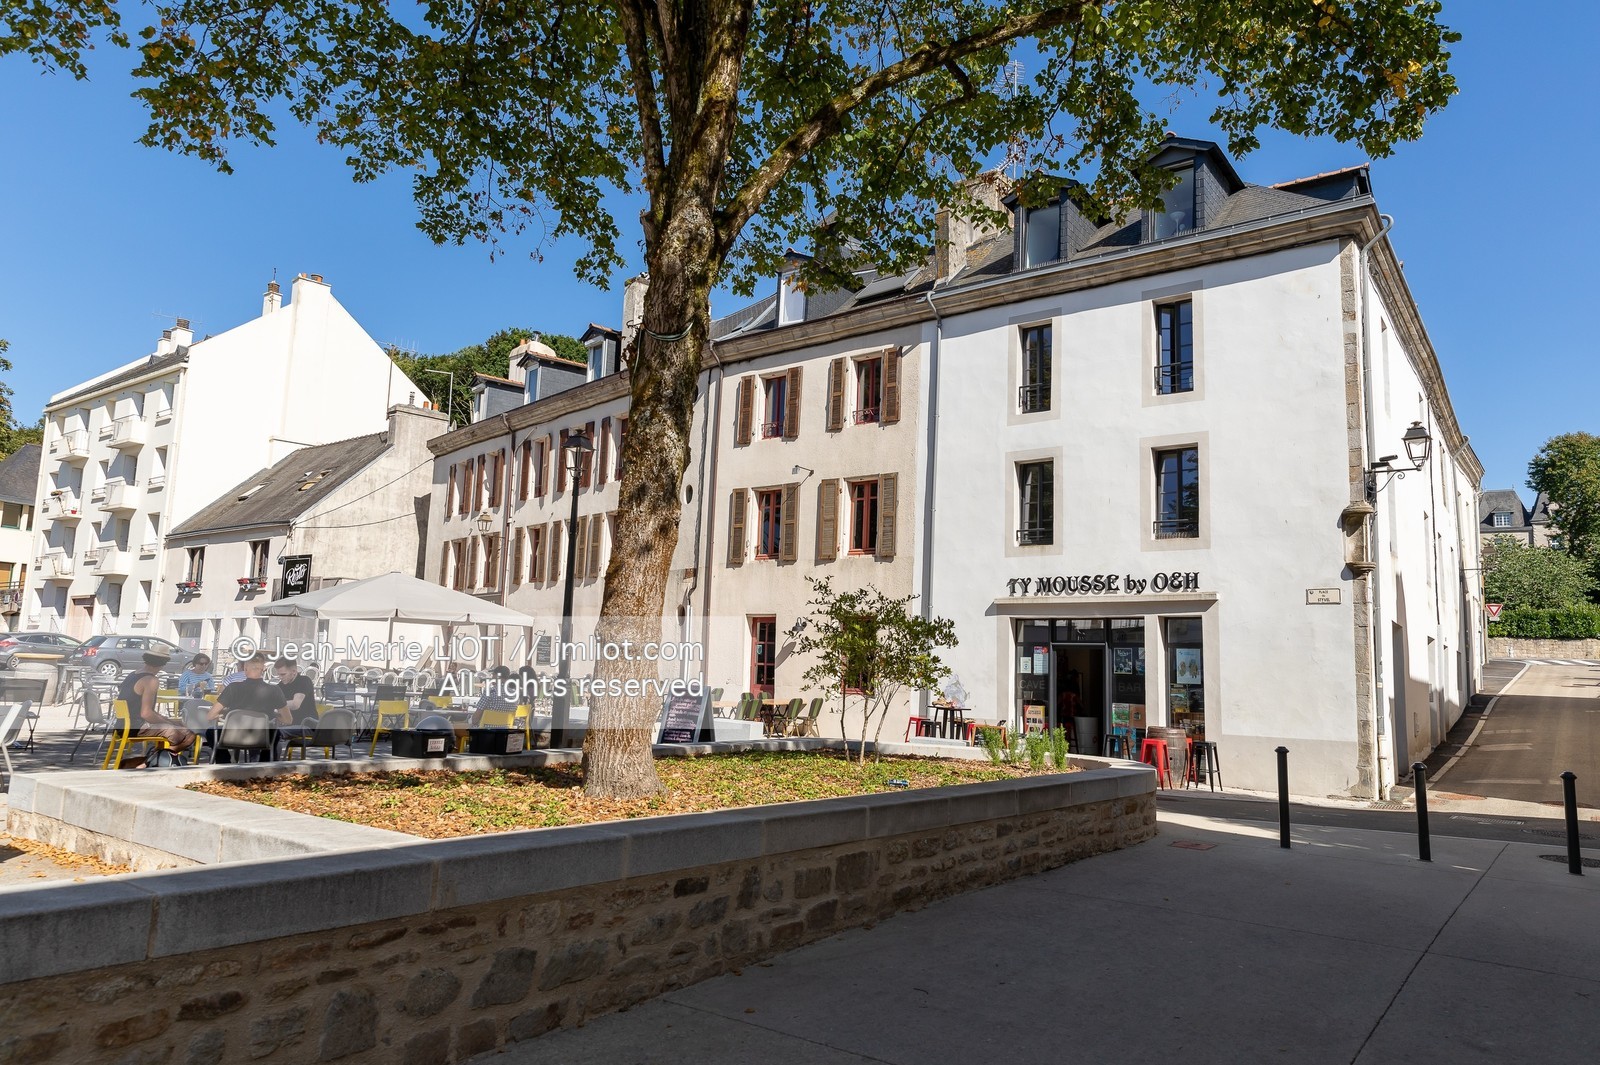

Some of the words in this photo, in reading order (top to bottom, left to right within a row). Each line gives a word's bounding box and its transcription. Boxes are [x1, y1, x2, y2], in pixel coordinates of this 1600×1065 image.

[1007, 577, 1032, 594] TY
[1036, 574, 1120, 594] MOUSSE
[1125, 573, 1147, 595] by
[1153, 571, 1200, 591] O&H
[1019, 679, 1046, 690] CAVE
[1118, 682, 1142, 693] BAR
